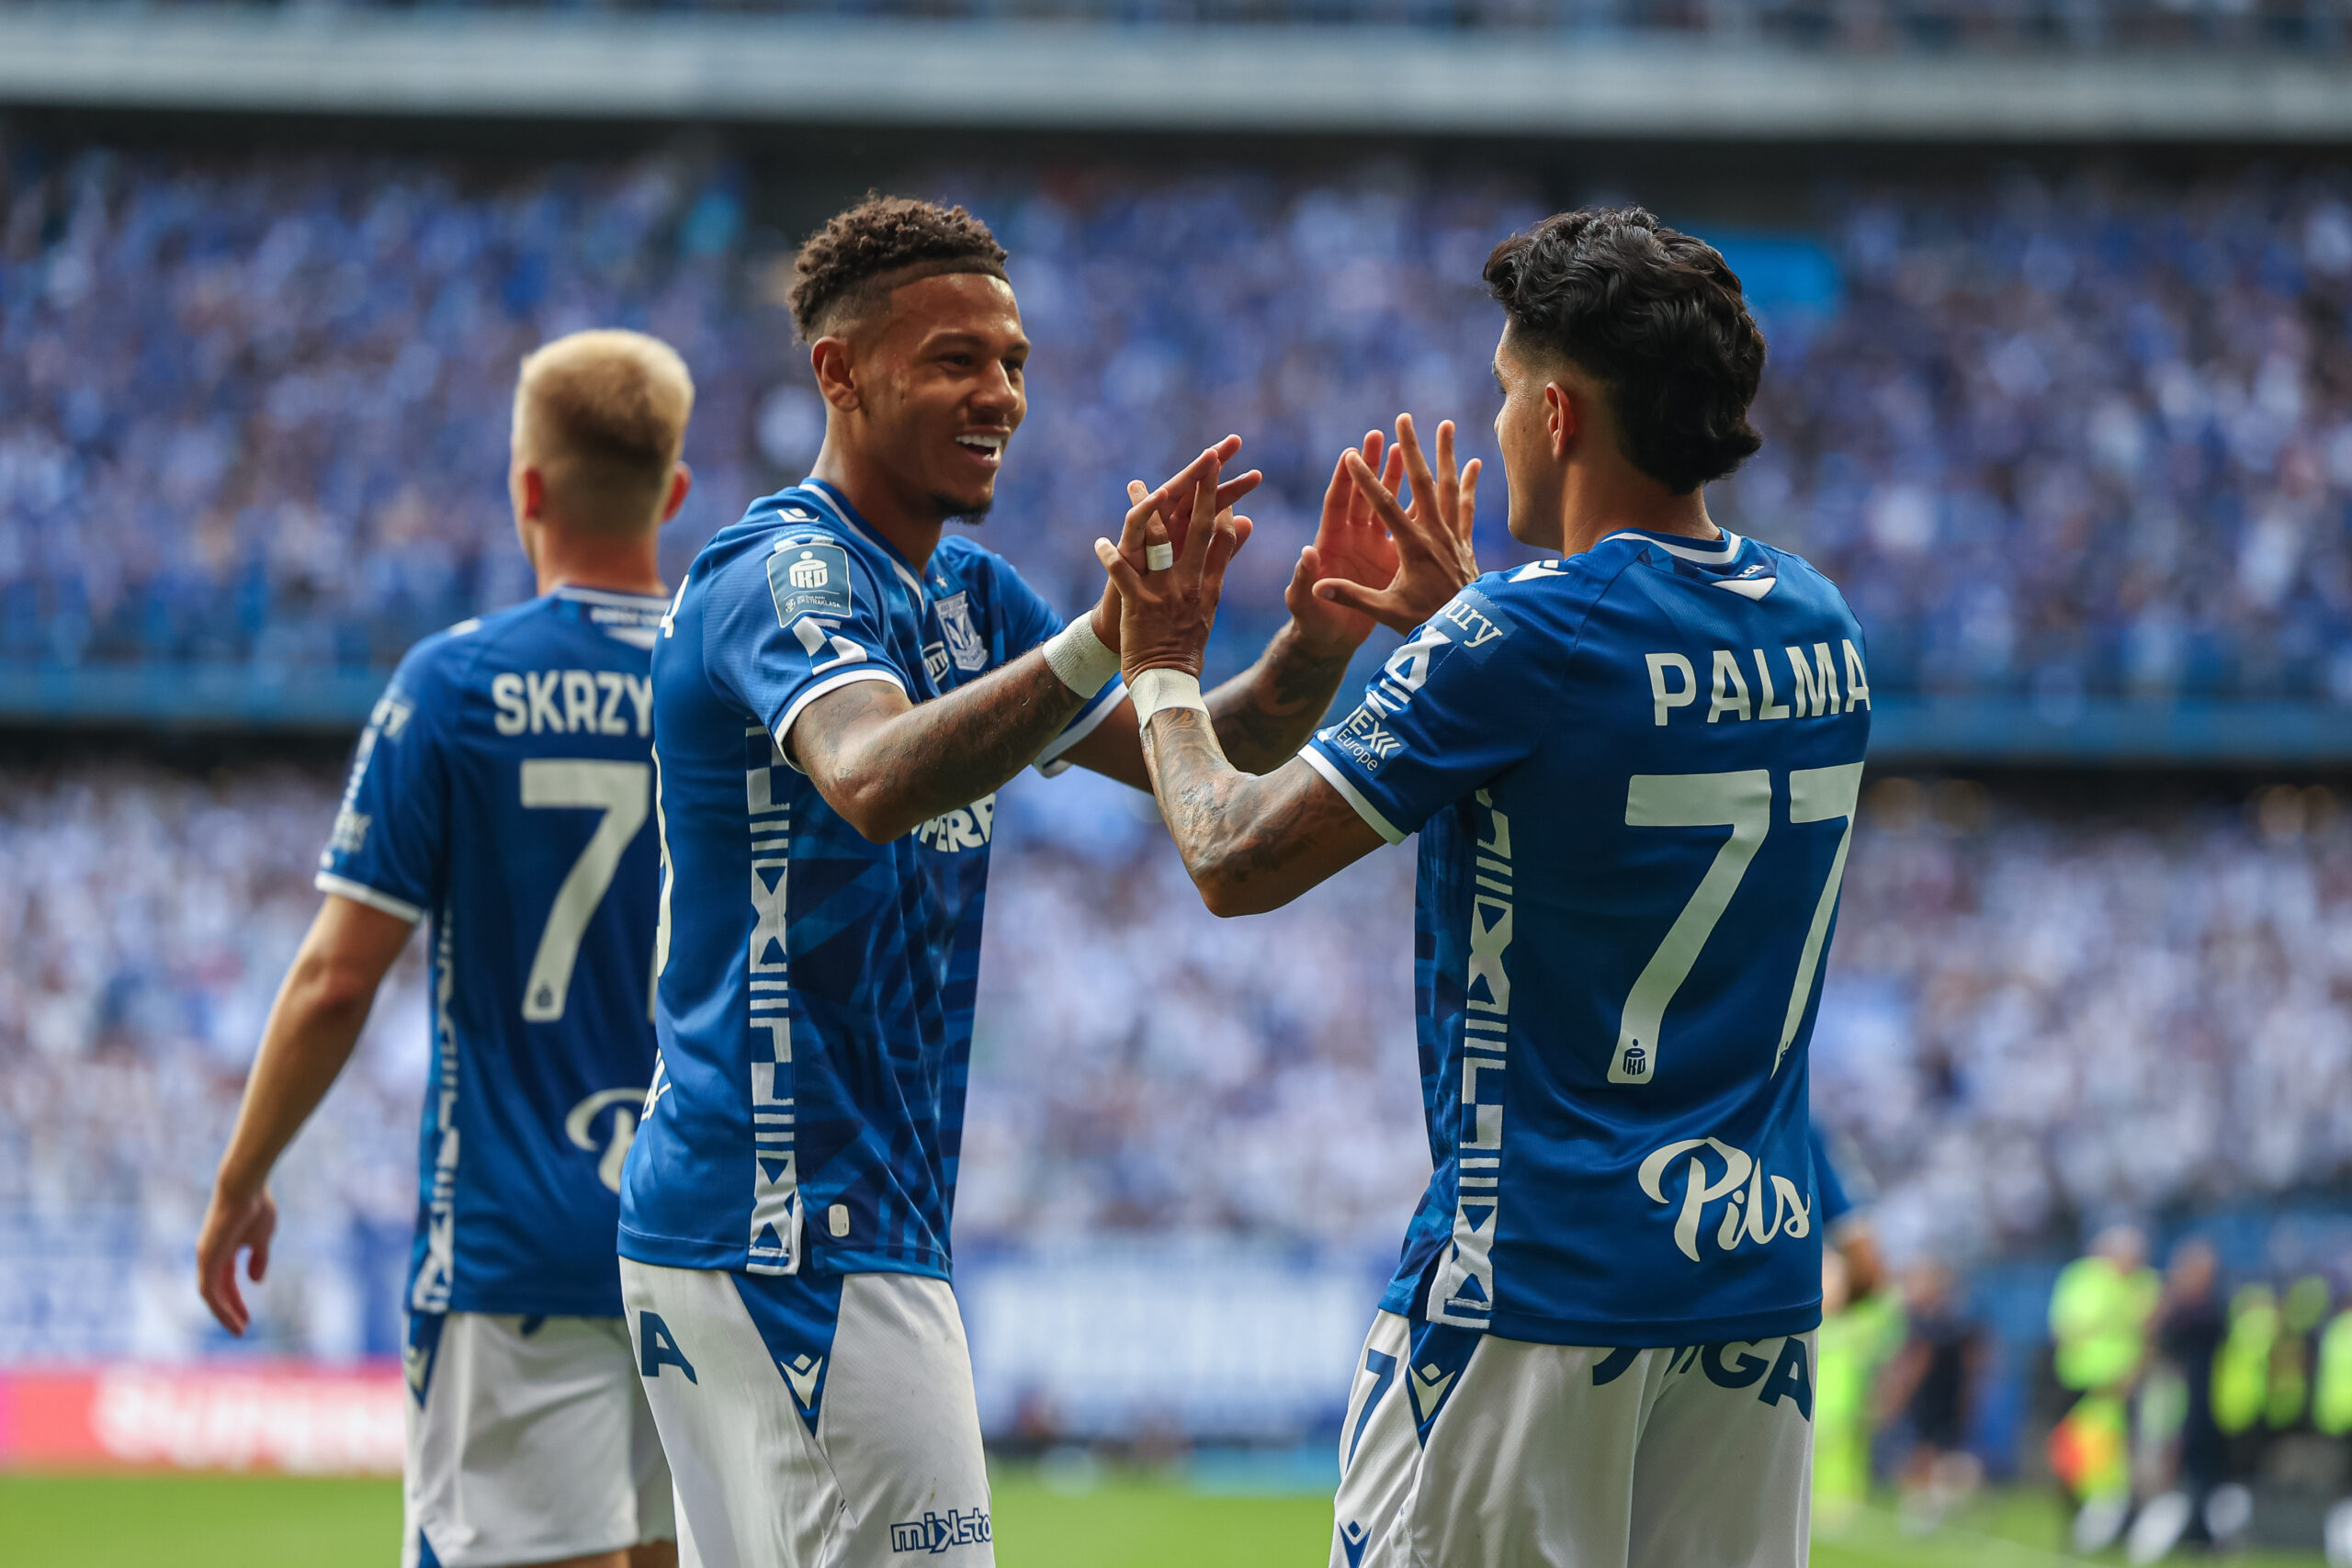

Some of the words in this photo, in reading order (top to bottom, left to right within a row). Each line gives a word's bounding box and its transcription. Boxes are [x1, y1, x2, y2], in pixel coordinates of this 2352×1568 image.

[492, 669, 655, 738] SKRZY
[1644, 638, 1871, 727] PALMA
[1336, 728, 1378, 771] Europe
[520, 758, 658, 1025] 7
[1607, 761, 1864, 1084] 77
[1637, 1136, 1811, 1262] Pils
